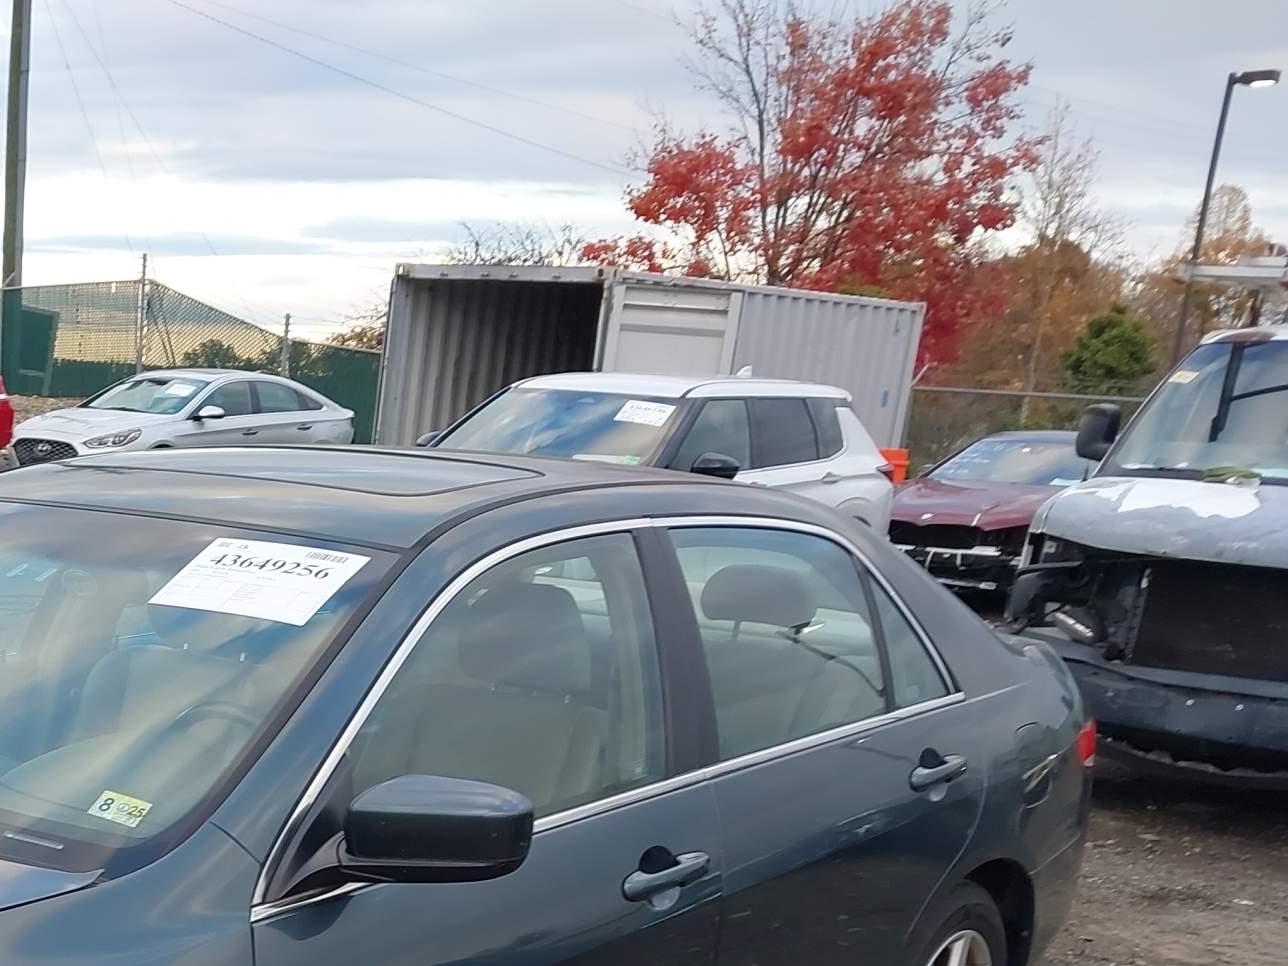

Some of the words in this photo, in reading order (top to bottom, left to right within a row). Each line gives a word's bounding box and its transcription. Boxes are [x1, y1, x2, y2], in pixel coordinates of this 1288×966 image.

[210, 553, 336, 580] 43649256
[98, 798, 115, 812] 8
[126, 806, 146, 819] 25
